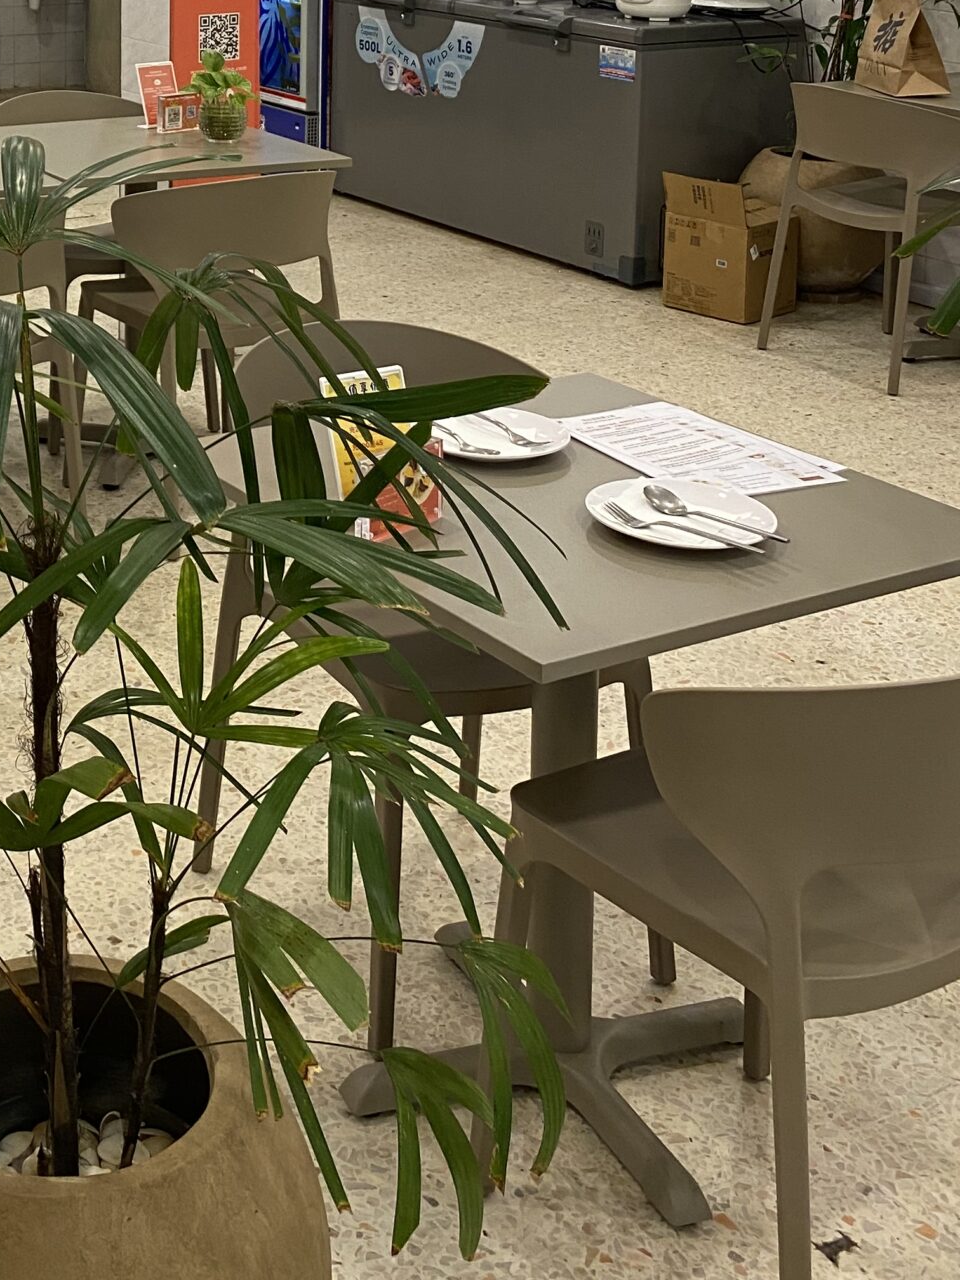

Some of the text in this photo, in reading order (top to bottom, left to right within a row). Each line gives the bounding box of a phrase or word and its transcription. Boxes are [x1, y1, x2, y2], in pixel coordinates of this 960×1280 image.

[359, 39, 381, 53] 500L
[386, 35, 455, 68] ULTRA WIDE
[457, 39, 472, 54] 1.6
[388, 66, 394, 76] 5
